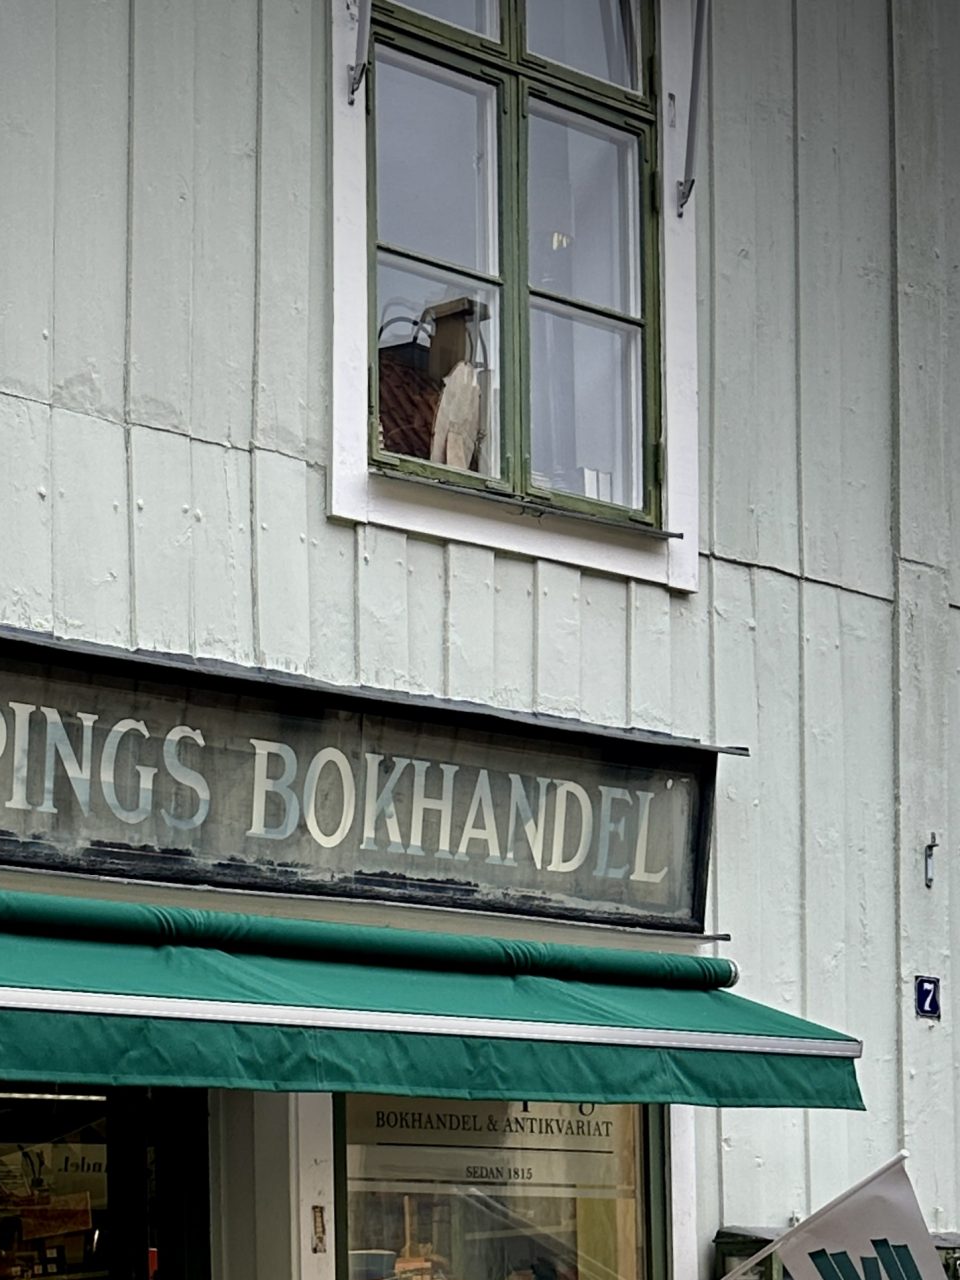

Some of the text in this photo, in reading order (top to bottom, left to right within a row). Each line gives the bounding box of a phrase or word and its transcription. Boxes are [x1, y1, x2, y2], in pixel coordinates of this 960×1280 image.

[246, 738, 668, 883] BOKHANDEL
[922, 983, 936, 1011] 7
[376, 1110, 613, 1137] BOKHANDEL & ANTIKVARIAT
[465, 1165, 532, 1181] SEDAN 1815
